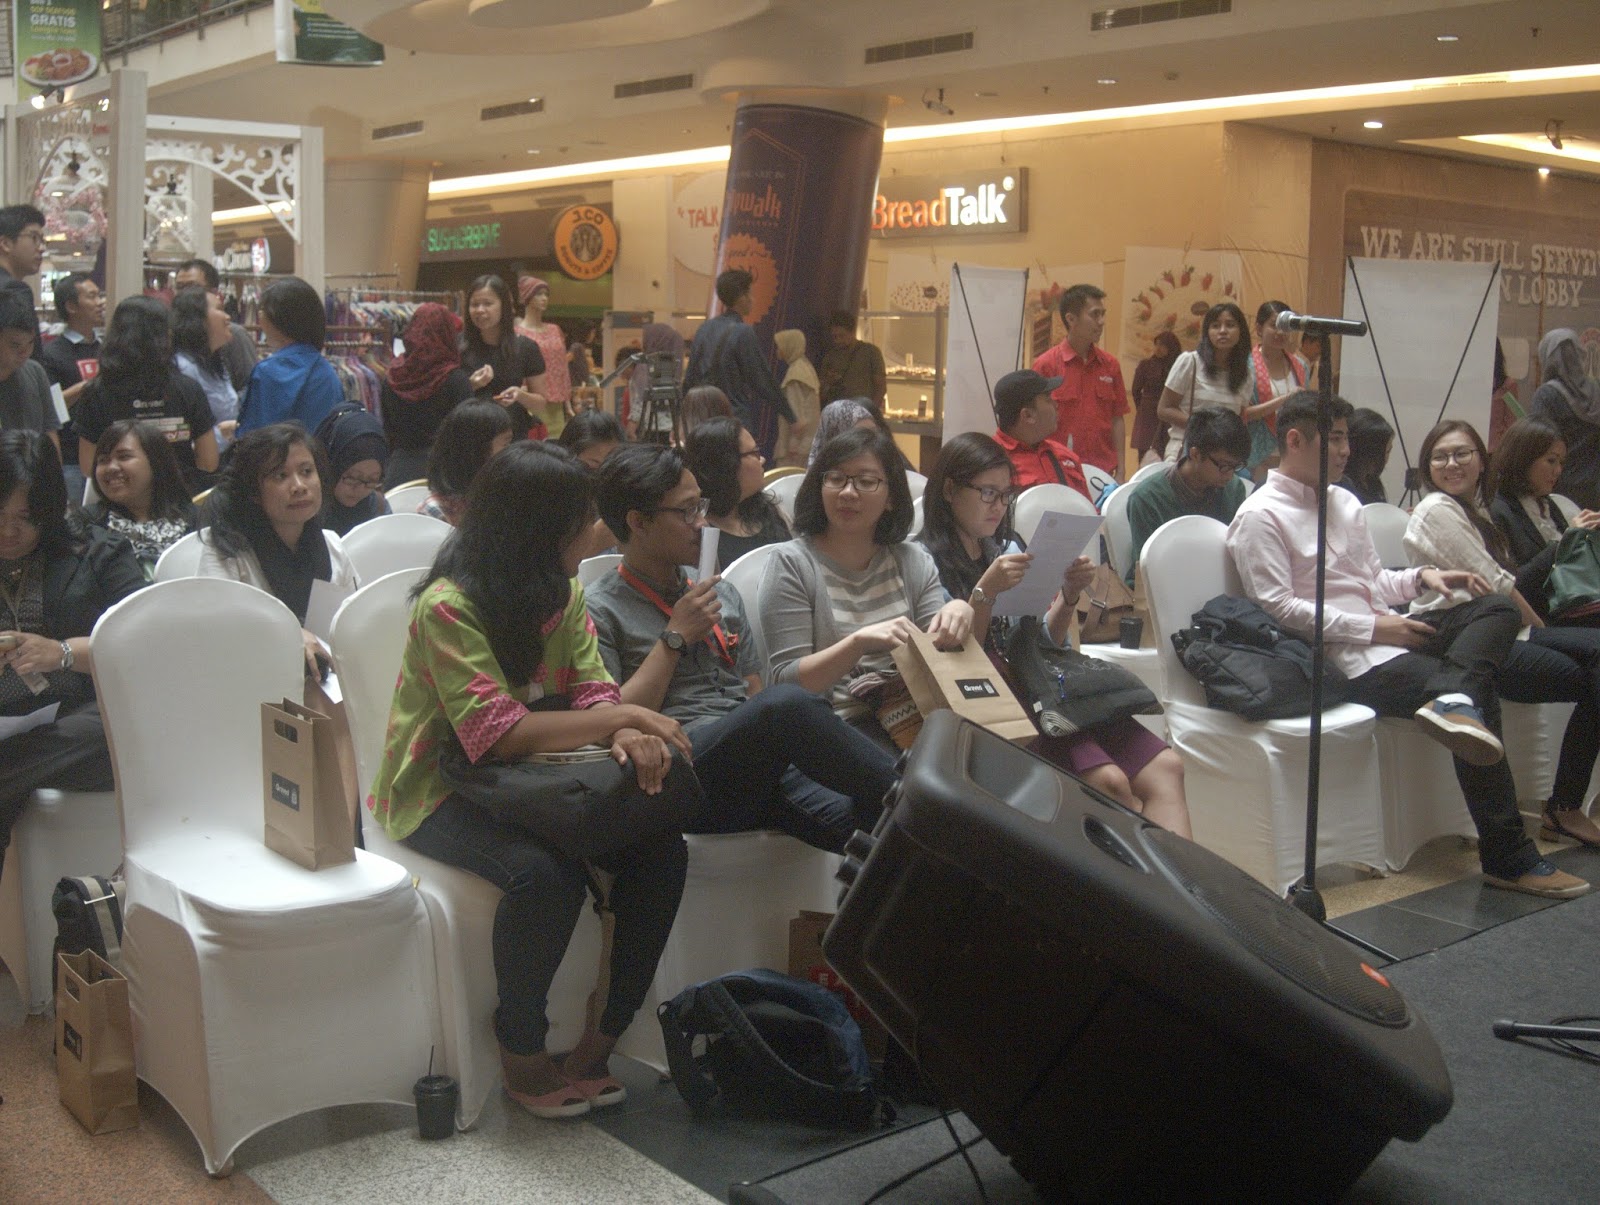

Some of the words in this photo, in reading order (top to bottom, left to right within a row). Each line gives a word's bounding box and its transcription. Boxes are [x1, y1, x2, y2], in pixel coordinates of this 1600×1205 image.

[30, 14, 76, 28] GRATIS
[1360, 225, 1403, 260] WE
[1408, 230, 1457, 262] ARE
[1462, 236, 1525, 272] STILL
[1518, 274, 1584, 308] LOBBY
